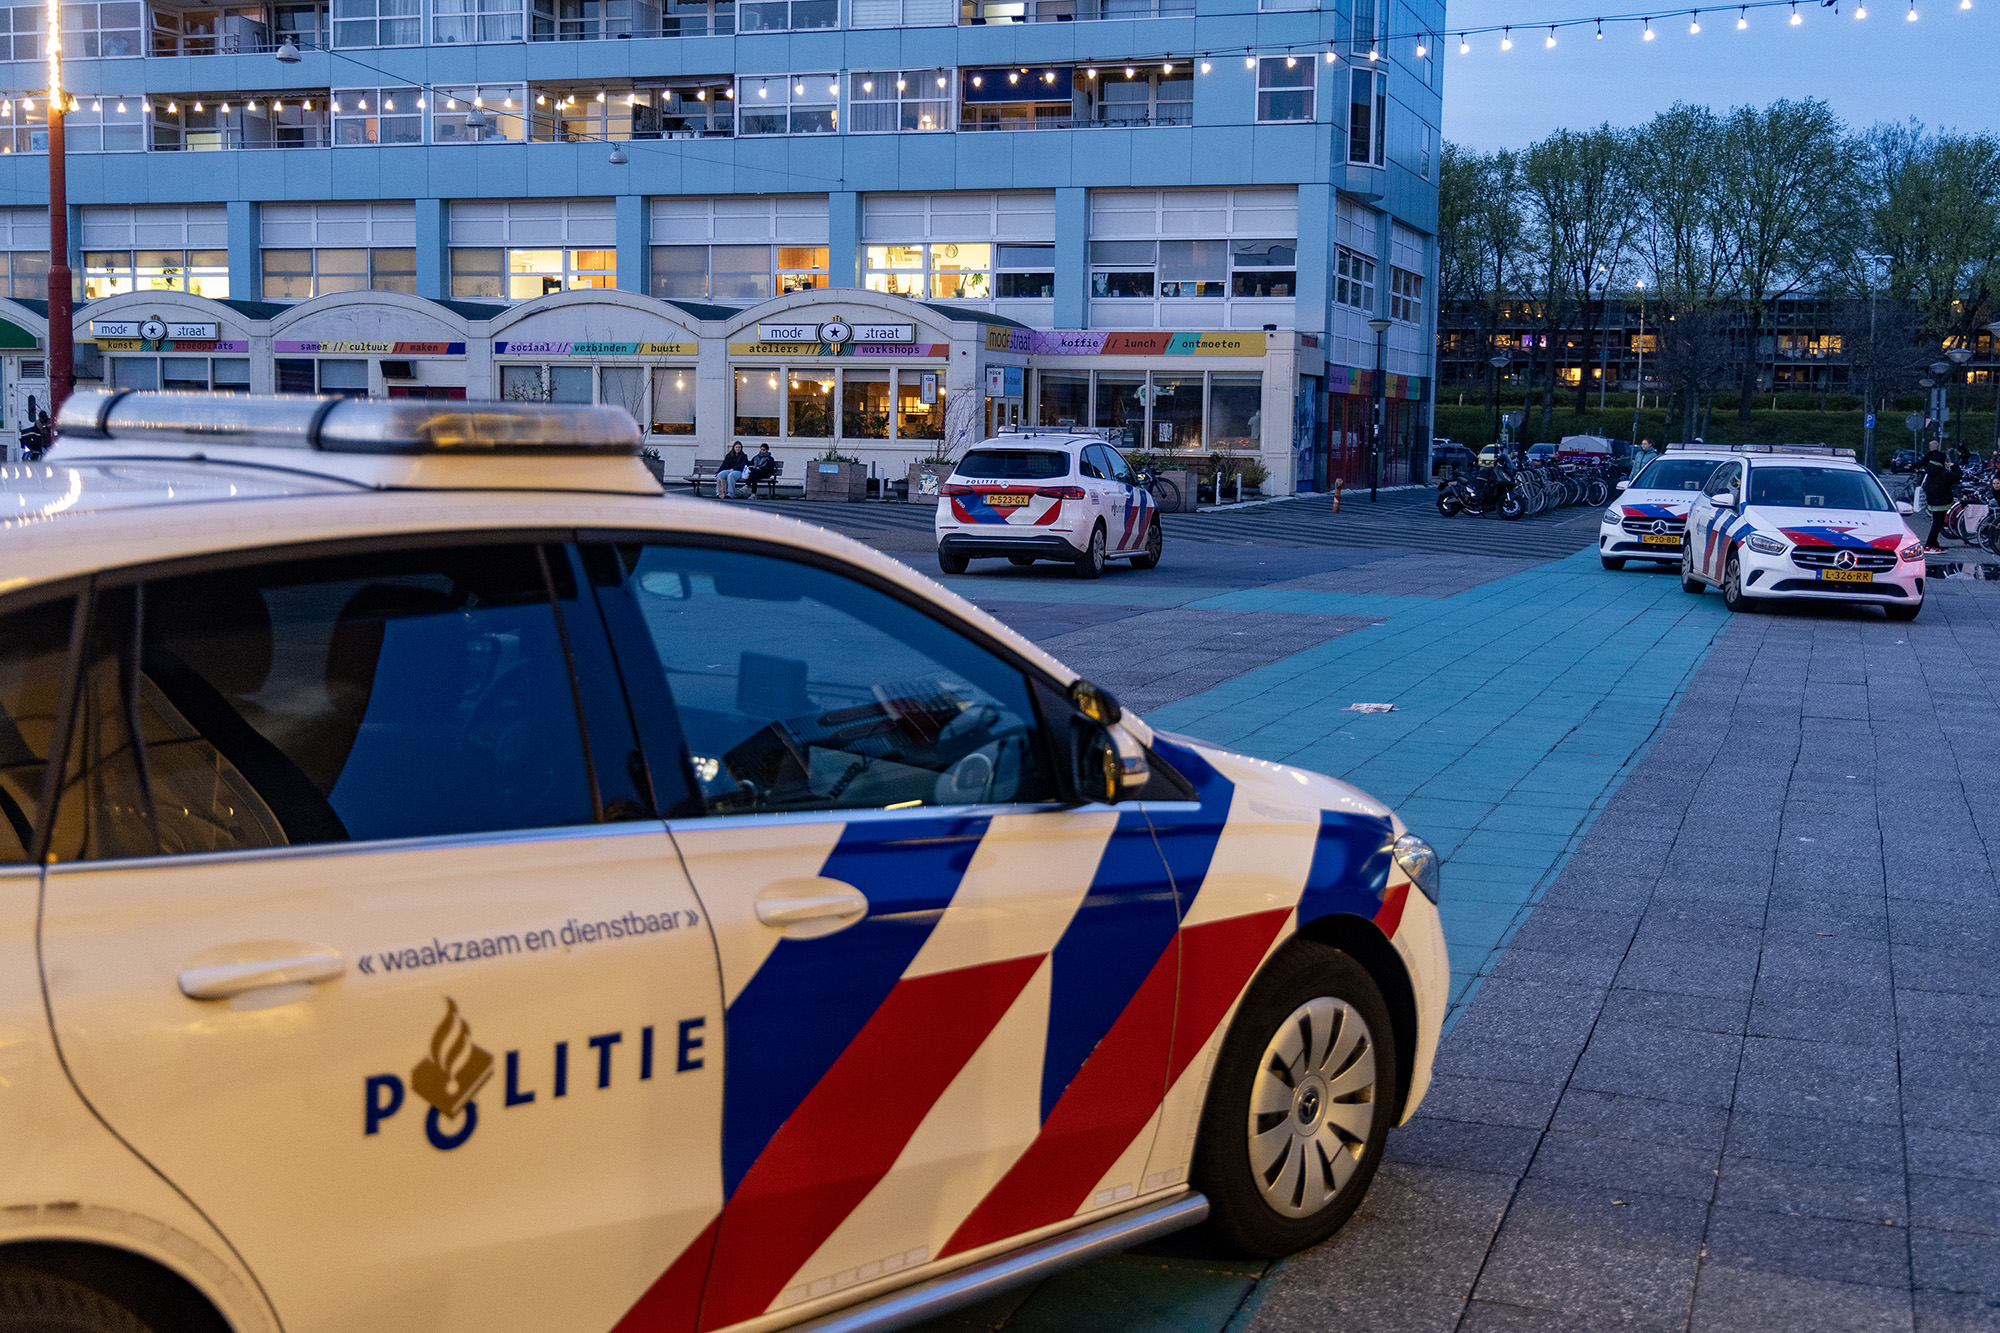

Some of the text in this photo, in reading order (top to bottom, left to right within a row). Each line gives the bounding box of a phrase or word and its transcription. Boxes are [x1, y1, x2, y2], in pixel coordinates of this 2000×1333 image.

[108, 340, 234, 350] kunst broedplaats
[300, 343, 328, 351] samen
[349, 342, 389, 351] cultuur
[410, 343, 438, 352] maken
[510, 343, 551, 352] sociaal
[574, 343, 627, 352] verbinden
[650, 344, 681, 353] buurt
[1061, 338, 1099, 348] koffie
[1125, 339, 1156, 348] lunch
[1182, 340, 1241, 348] ontmoeten
[749, 343, 799, 353] ateliers
[862, 344, 920, 355] workshops
[989, 495, 1026, 504] P-523-GX
[1825, 571, 1869, 581] L-326-RR
[379, 937, 522, 972] waakzaam
[525, 928, 557, 951] en
[559, 909, 681, 946] dienstbaar
[364, 1016, 706, 1151] POLITIE
